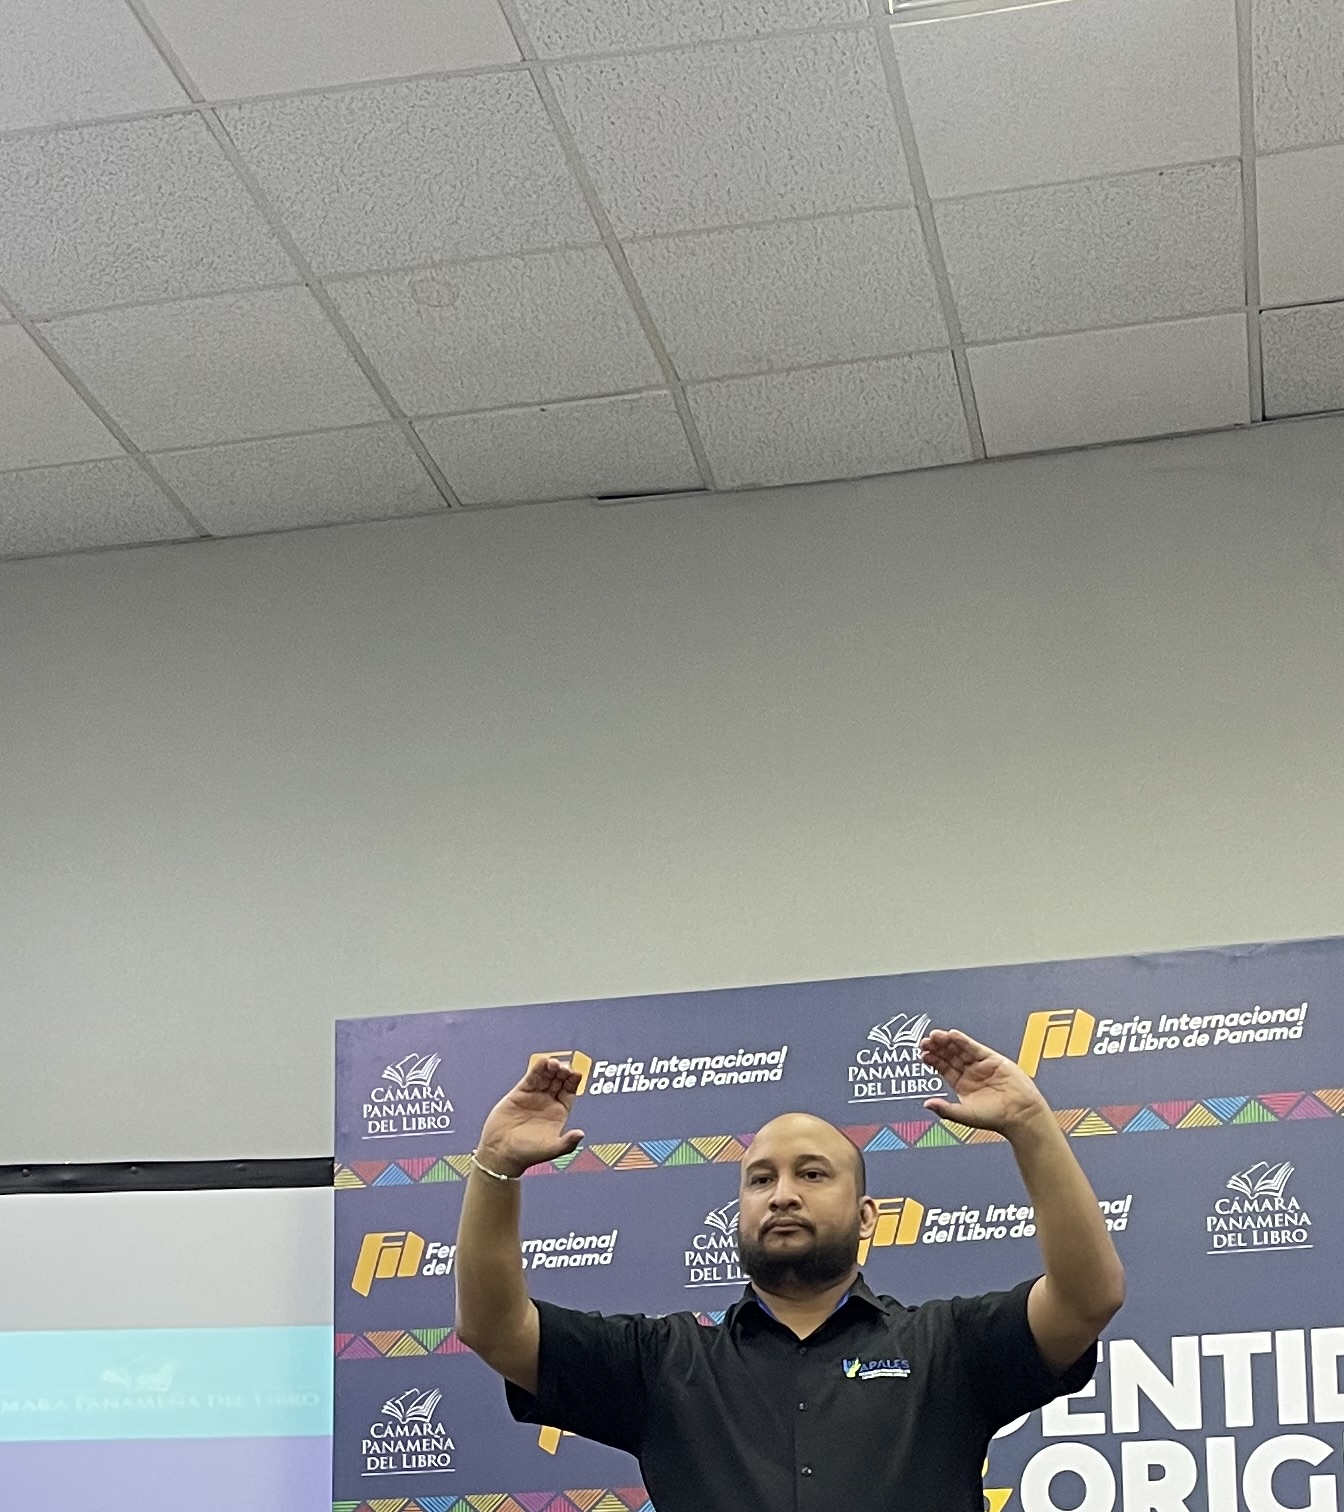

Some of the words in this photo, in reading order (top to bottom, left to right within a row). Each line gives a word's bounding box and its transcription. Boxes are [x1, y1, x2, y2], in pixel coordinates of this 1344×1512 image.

[1096, 1015, 1153, 1039] Feria
[1157, 1002, 1308, 1033] Internacional
[1093, 1035, 1128, 1055] del
[1128, 1032, 1181, 1053] Libro
[1182, 1029, 1210, 1048] de
[1213, 1020, 1304, 1046] Panamá
[592, 1057, 645, 1079] Feria
[649, 1045, 788, 1075] Internacional
[856, 1045, 924, 1065] CÁMAR
[589, 1076, 621, 1095] del
[621, 1074, 670, 1093] Libro
[671, 1071, 697, 1089] de
[700, 1068, 783, 1087] Panamá
[854, 1082, 887, 1097] DEL
[890, 1077, 943, 1095] LIBRO
[370, 1085, 445, 1103] CÁMARA
[362, 1095, 455, 1119] PANAMEÑA
[367, 1119, 398, 1134] DEL
[402, 1115, 451, 1131] LIBRO
[1214, 1196, 1301, 1215] CÁMARA
[924, 1205, 980, 1229] Feria
[1206, 1212, 1312, 1232] PANAMEÑA
[922, 1224, 956, 1244] del
[956, 1222, 1007, 1242] Libro
[1009, 1220, 1036, 1238] de
[1213, 1232, 1248, 1249] DEL
[1252, 1228, 1308, 1246] LIBRO
[422, 1258, 454, 1276] del
[531, 1252, 613, 1270] Panamá
[690, 1266, 722, 1283] DEL
[370, 1420, 446, 1439] CÁMARA
[362, 1437, 456, 1455] PANAMEÑA
[366, 1456, 397, 1471] DEL
[402, 1453, 451, 1469] LIBRO
